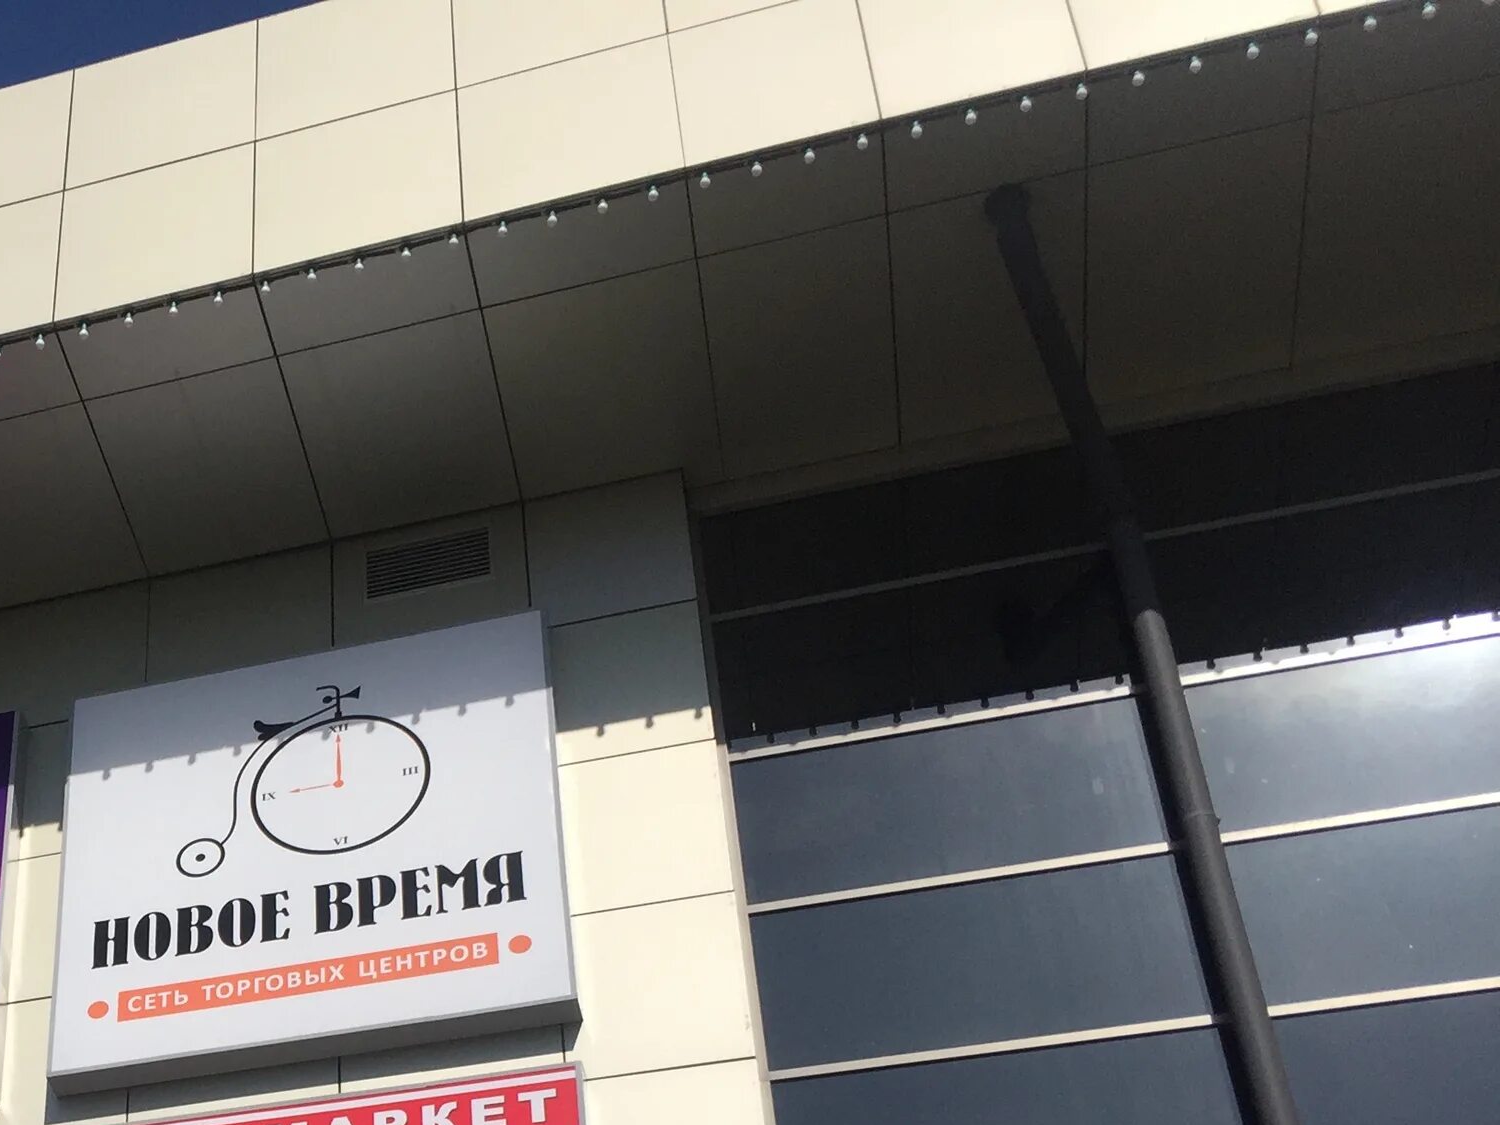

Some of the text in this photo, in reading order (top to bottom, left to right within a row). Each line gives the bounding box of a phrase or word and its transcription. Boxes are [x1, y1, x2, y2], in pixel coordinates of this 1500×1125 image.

[91, 850, 528, 970] НОВОЕ ВРЕМЯ
[127, 941, 489, 1013] СЕТЬ ТОРГОВЫХ ЦЕНТРОВ
